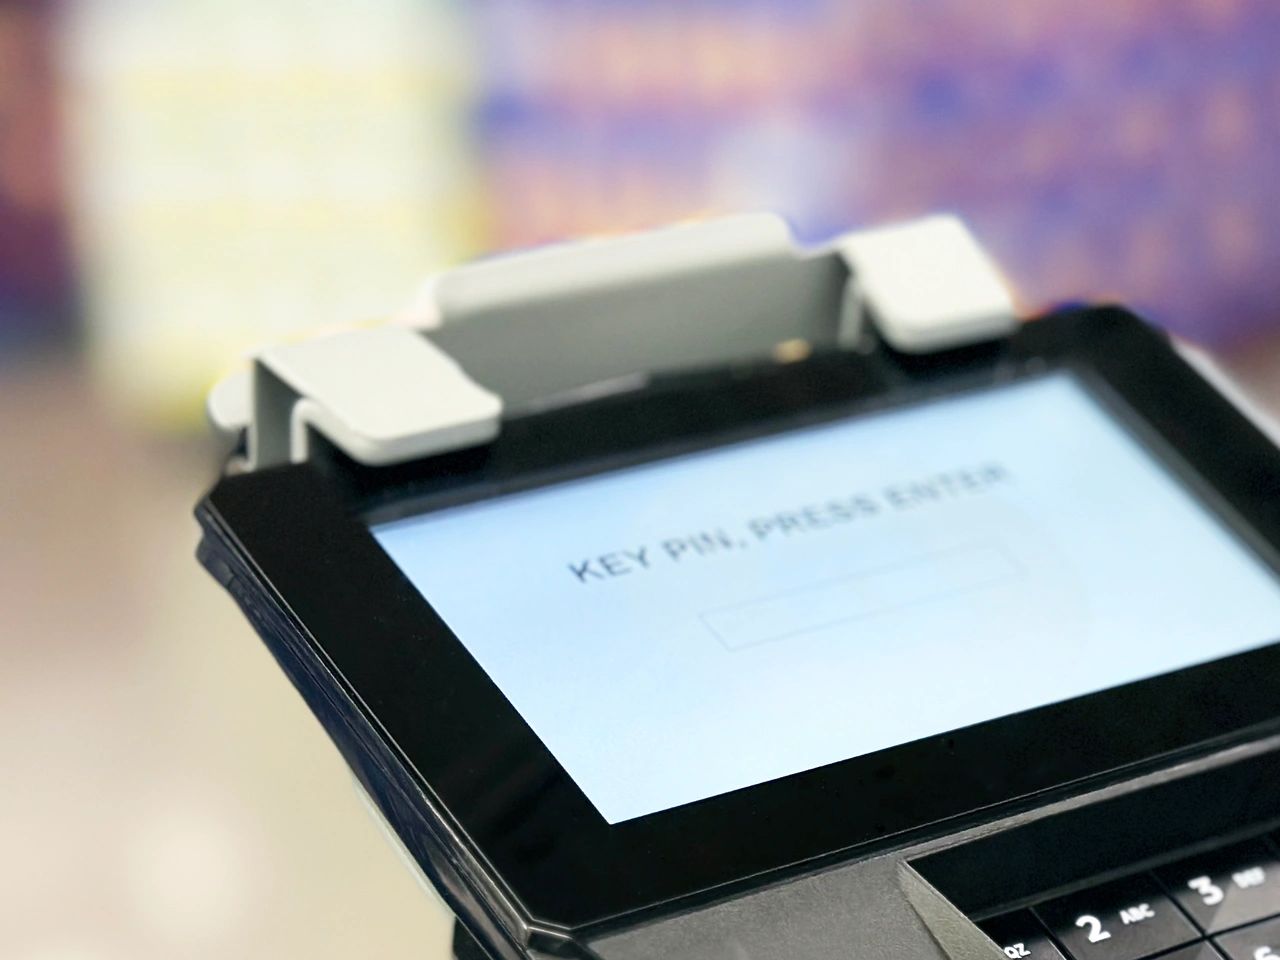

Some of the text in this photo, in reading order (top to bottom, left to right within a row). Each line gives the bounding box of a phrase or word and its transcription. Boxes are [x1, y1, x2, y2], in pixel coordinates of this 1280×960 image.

[568, 461, 1013, 583] KEY PIN, PRESS ENTER
[1187, 875, 1224, 906] 3
[1075, 903, 1156, 944] 2 ABC
[1003, 942, 1032, 960] QZ
